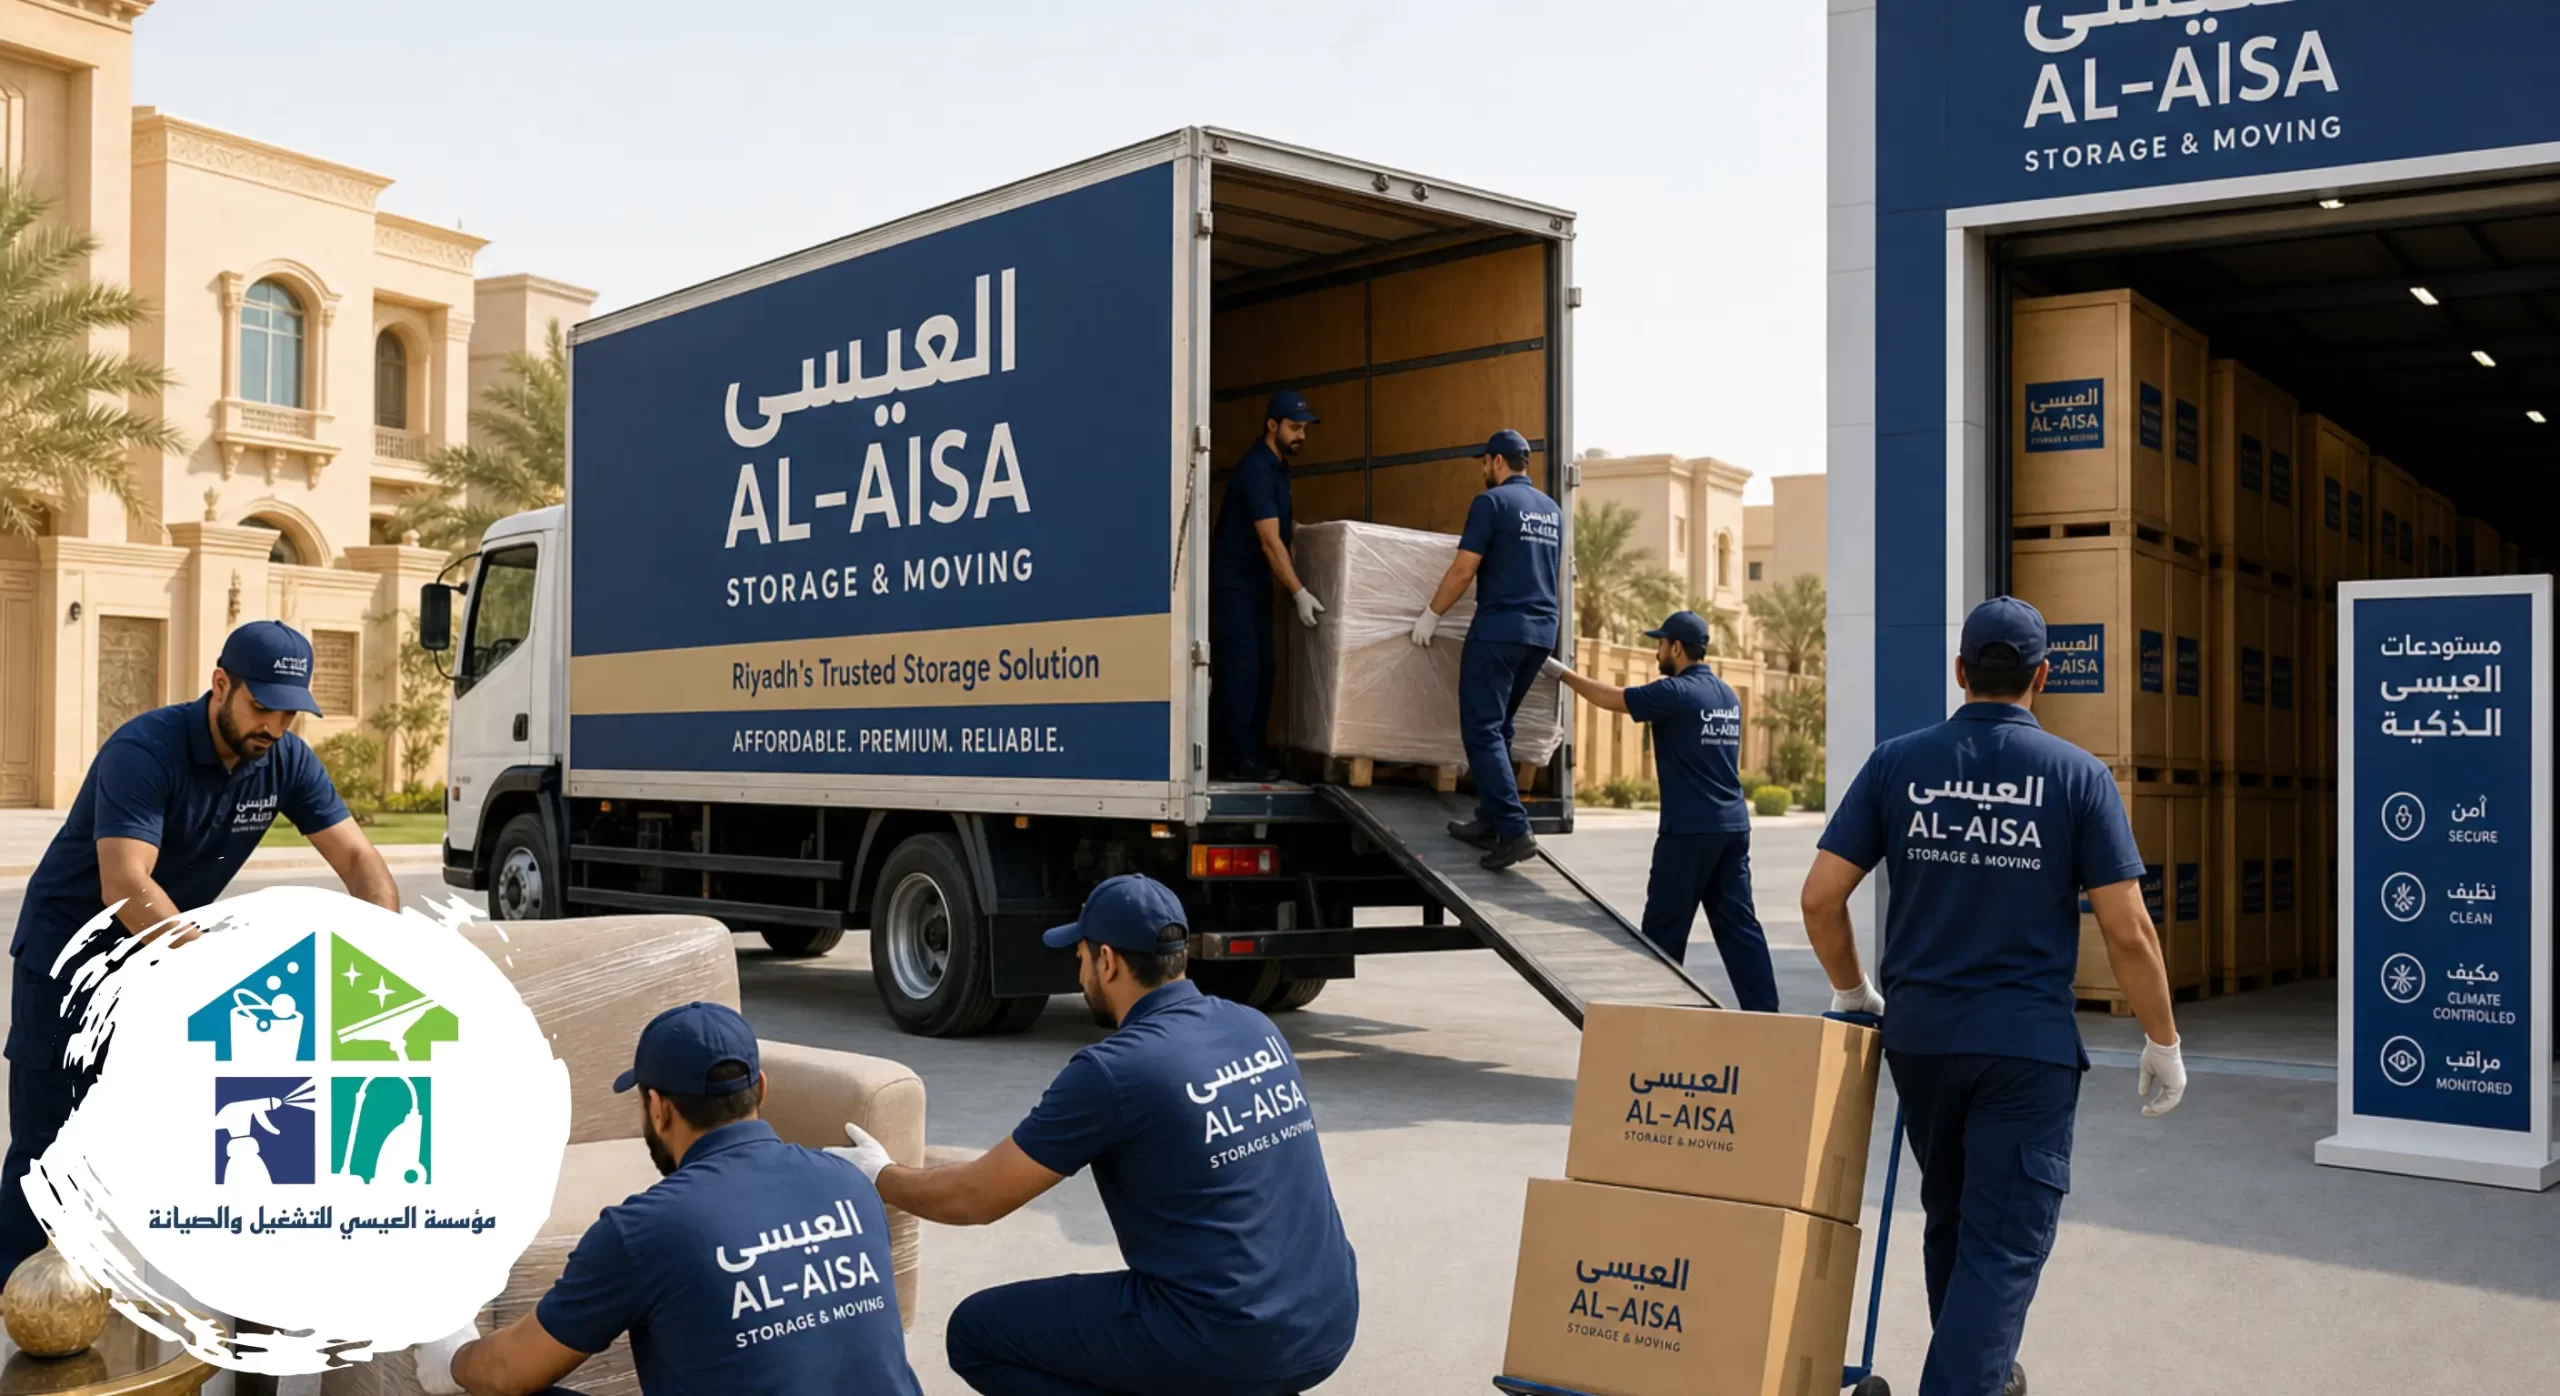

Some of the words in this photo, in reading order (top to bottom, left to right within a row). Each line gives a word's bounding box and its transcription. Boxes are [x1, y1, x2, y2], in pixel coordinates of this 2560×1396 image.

[2023, 30, 2339, 128] AL-AISA
[2024, 135, 2167, 171] STORAGE
[2181, 132, 2199, 155] &
[2213, 116, 2341, 151] MOVING
[724, 267, 1016, 448] العيسى
[2030, 413, 2099, 432] AL-AISA
[724, 421, 1031, 549] AL-AISA
[726, 566, 857, 607] STORAGE
[872, 563, 890, 594] &
[903, 548, 1033, 592] MOVING
[2381, 634, 2501, 660] مستودعات
[732, 660, 814, 697] Riyadh's
[819, 655, 896, 689] Trusted
[903, 652, 991, 691] Storage
[999, 646, 1100, 681] Solution
[2049, 659, 2099, 675] -AISA
[2380, 665, 2501, 701] العيسى
[732, 730, 853, 754] AFFORDABLE.
[860, 728, 954, 754] PREMIUM.
[961, 727, 1065, 754] RELIABLE.
[2381, 708, 2501, 744] الذكية
[1908, 775, 2044, 810] العيسى
[1907, 811, 2042, 849] AL-AISA
[2448, 829, 2498, 843] SECURE
[1907, 848, 1967, 864] STORAGE
[1971, 853, 1980, 865] &
[1984, 855, 2041, 870] MOVING
[2447, 882, 2496, 904] نظيف
[2450, 911, 2492, 925] CLEAN
[2447, 962, 2499, 985] مكيف
[2433, 1007, 2516, 1024] CONTROLLED
[2447, 991, 2501, 1006] CLIMATE
[1186, 1035, 1289, 1104] العيسى
[2446, 1050, 2501, 1074] مراقب
[1629, 1065, 1739, 1098] العيسى
[2436, 1077, 2512, 1095] MONITORED
[1205, 1080, 1307, 1144] AL-AISA
[1625, 1099, 1735, 1135] AL-AISA
[1210, 1135, 1271, 1168] STORAGE
[1271, 1133, 1280, 1145] &
[1624, 1130, 1673, 1145] STORAGE
[1688, 1138, 1734, 1152] MOVING
[716, 1199, 863, 1273] العيسى
[731, 1252, 880, 1320] AL-AISA
[1576, 1257, 1689, 1291] العيسى
[735, 1313, 817, 1348] STORAGE
[819, 1310, 830, 1324] &
[833, 1296, 885, 1321] MOVING
[1569, 1288, 1682, 1333] AL-AISA
[1567, 1322, 1620, 1342] STORAGE
[1635, 1334, 1681, 1353] MOVING
